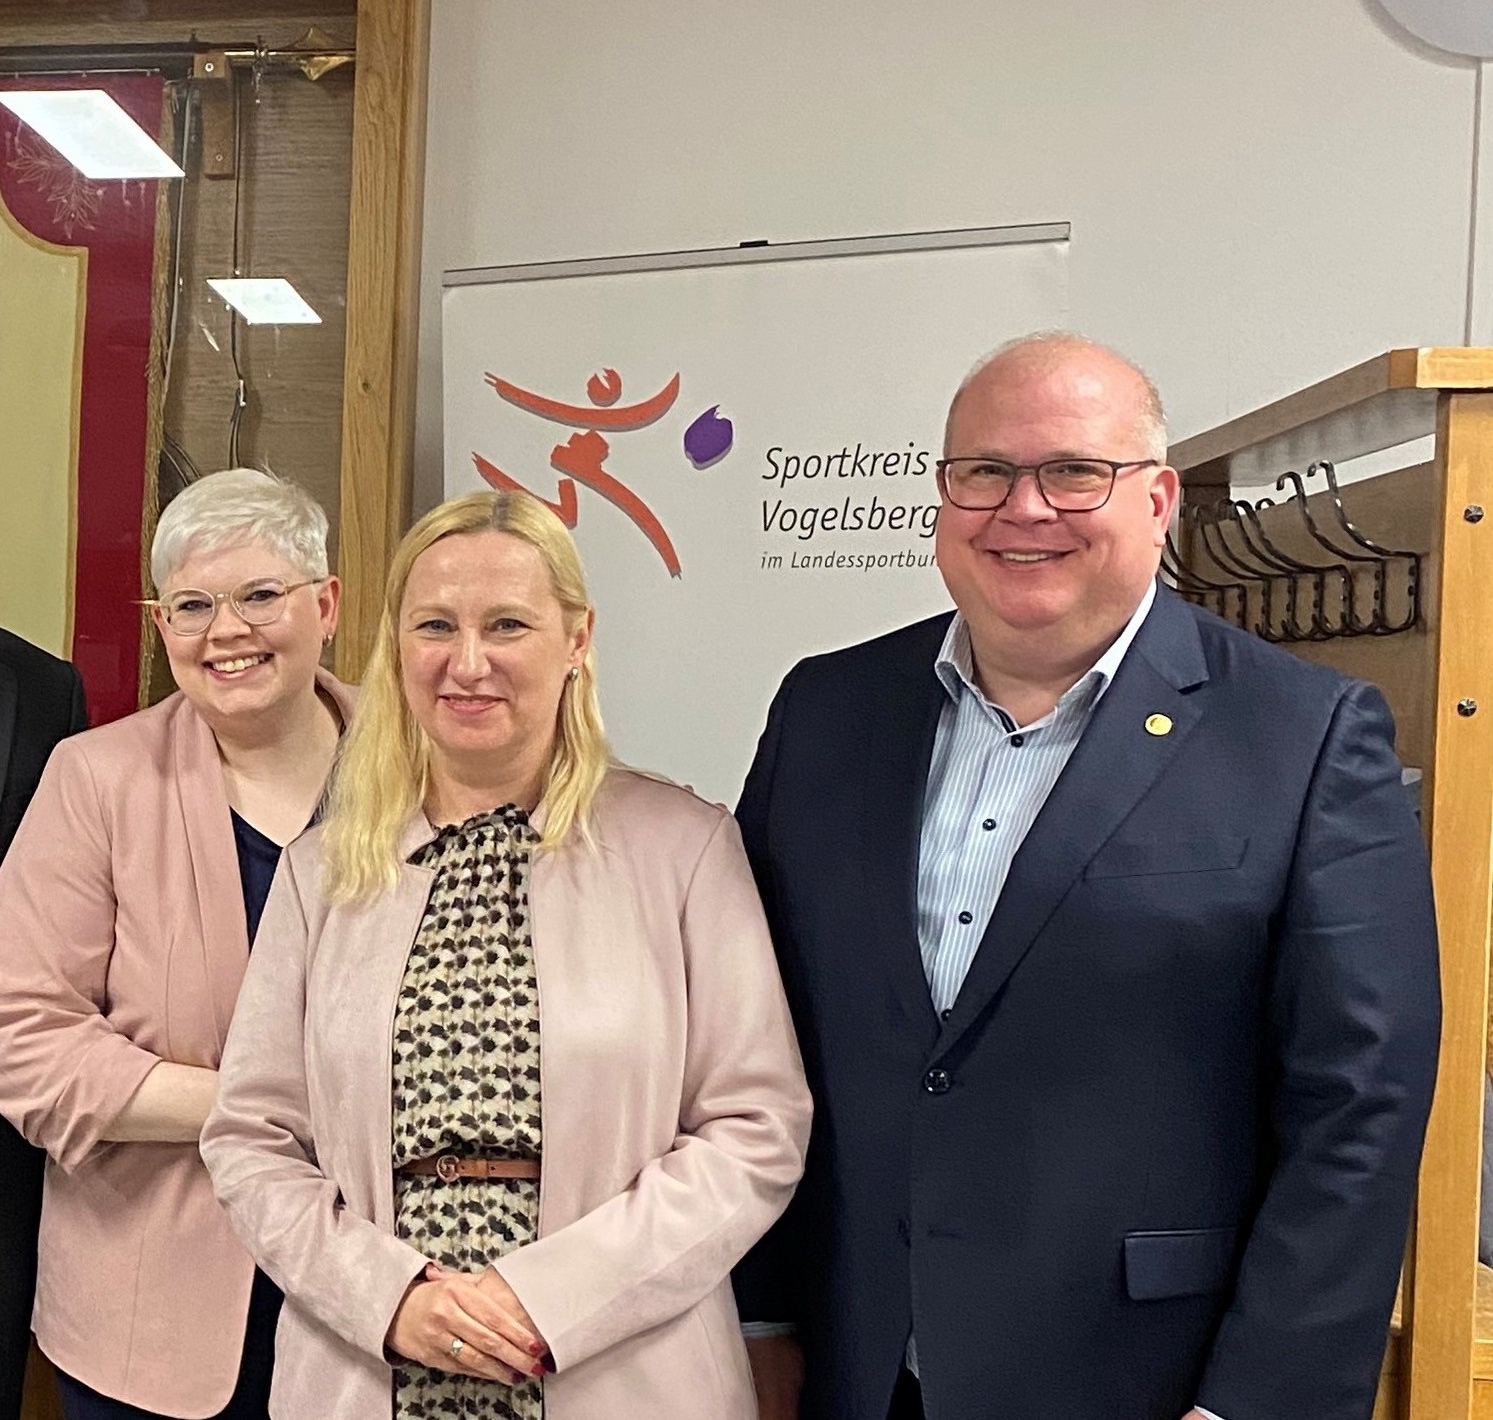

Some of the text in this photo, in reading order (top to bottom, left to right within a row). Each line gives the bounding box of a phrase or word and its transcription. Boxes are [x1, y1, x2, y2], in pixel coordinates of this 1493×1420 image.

[761, 441, 930, 489] Sportkreis
[762, 495, 942, 541] Vogelsberg
[760, 551, 783, 570] im
